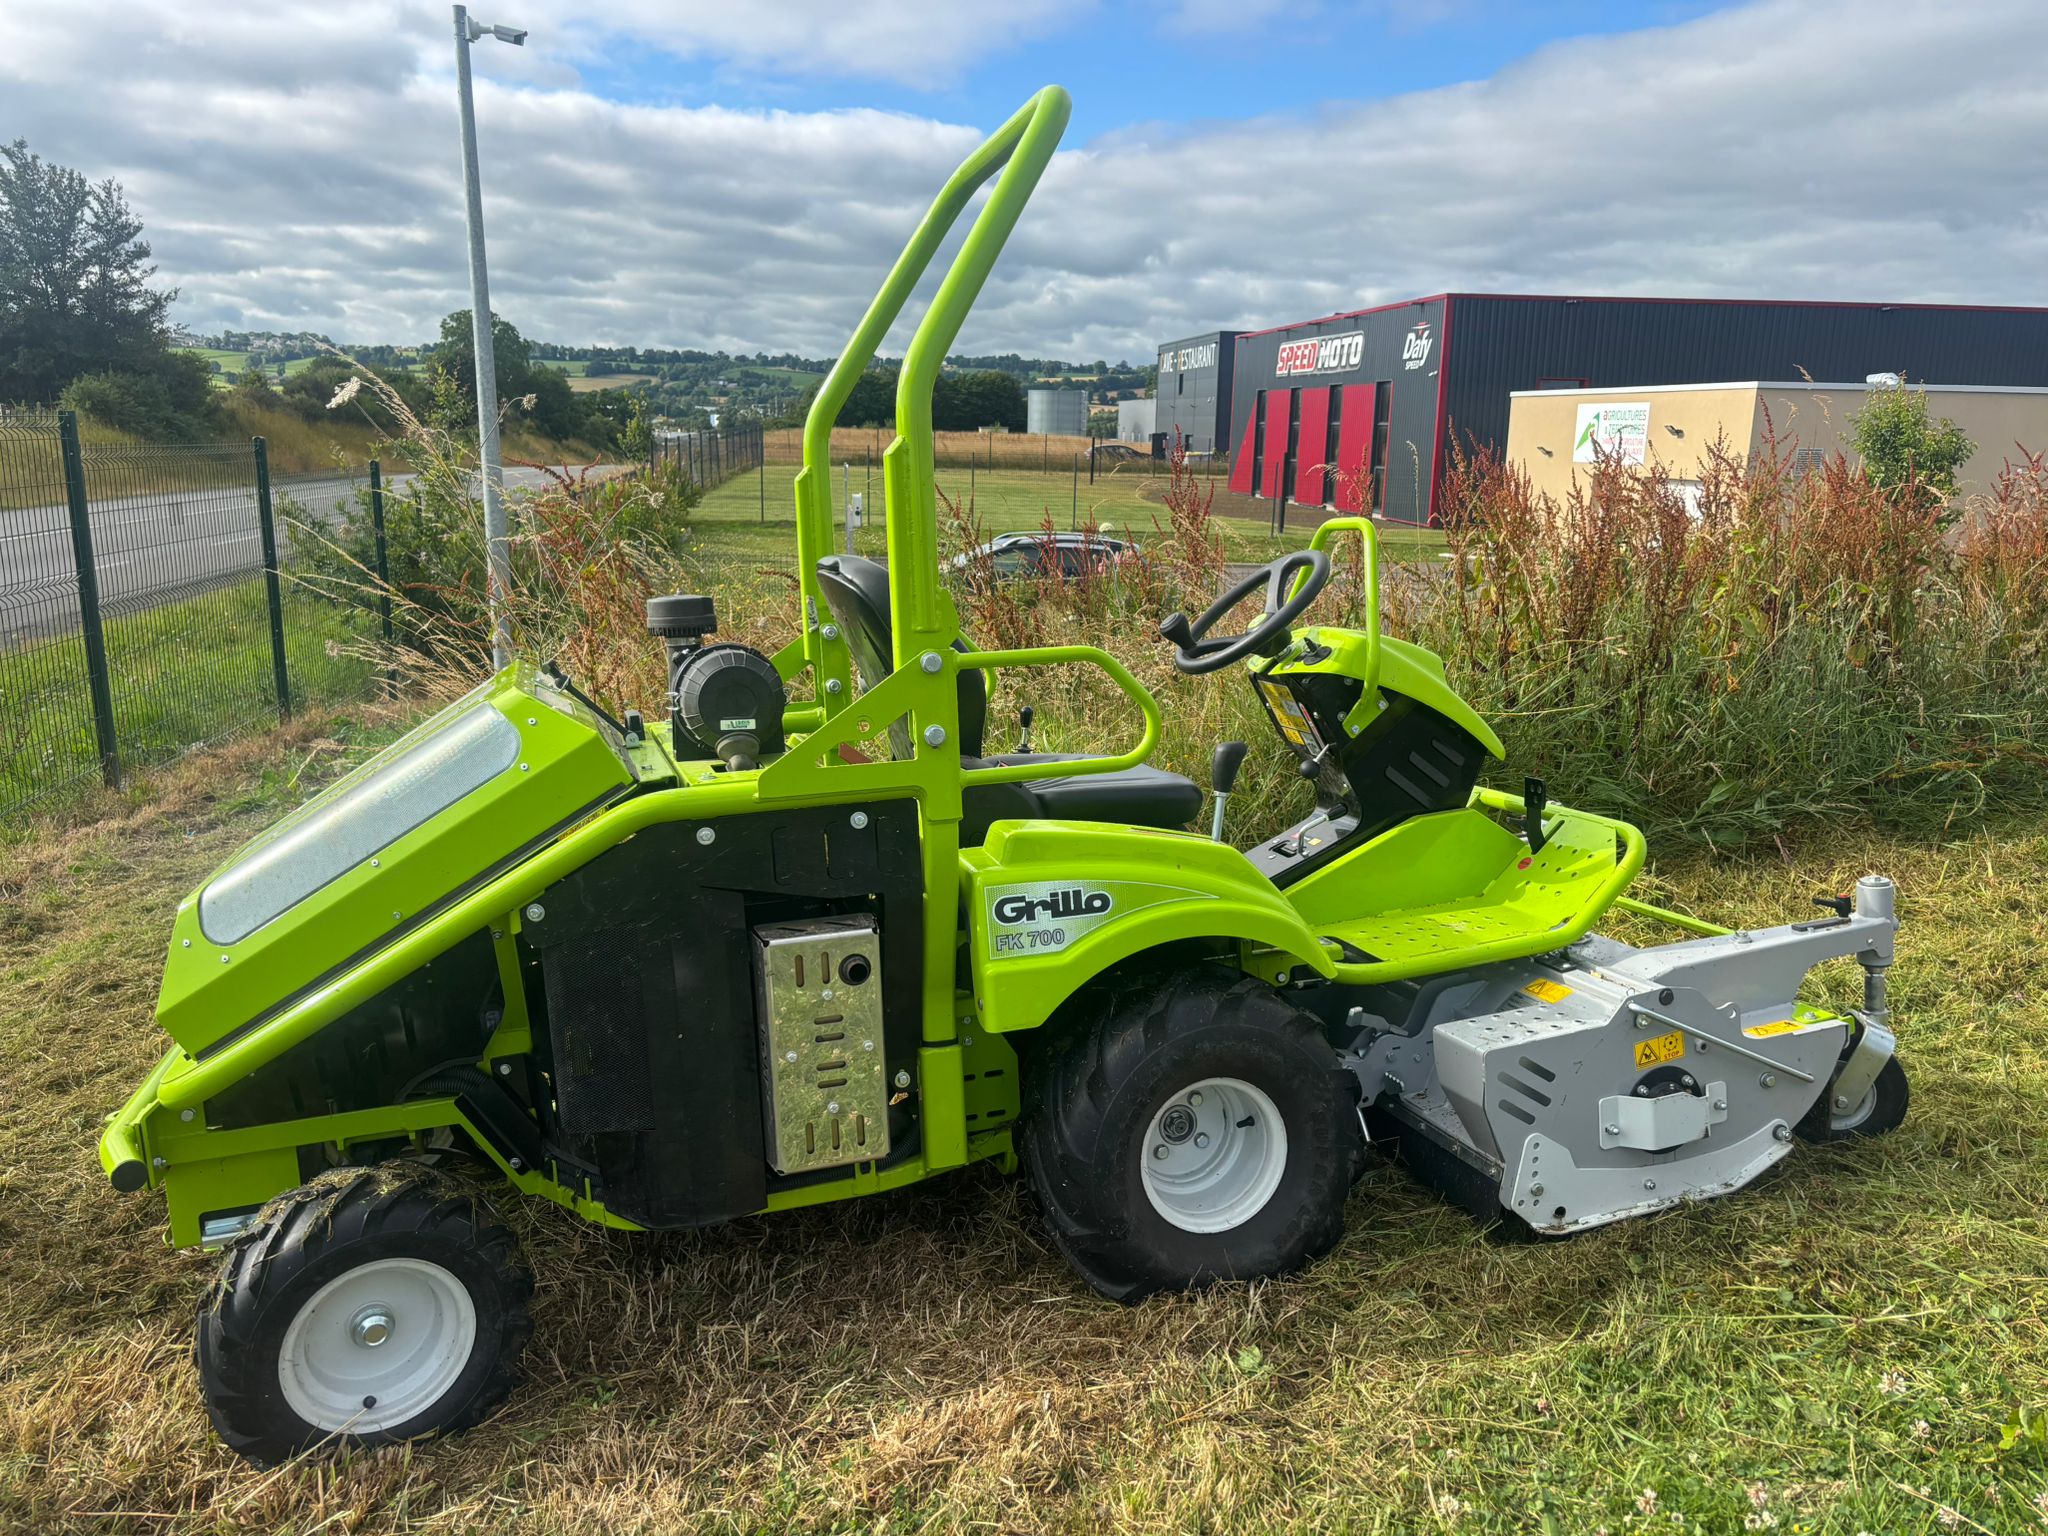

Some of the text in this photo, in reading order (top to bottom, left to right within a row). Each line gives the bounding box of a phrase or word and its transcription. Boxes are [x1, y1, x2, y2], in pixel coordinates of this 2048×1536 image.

[1178, 343, 1216, 371] RESTAURANT
[1276, 335, 1364, 373] SPEED MOTO
[1402, 330, 1433, 367] Dafy
[993, 888, 1112, 925] Grillo
[996, 928, 1066, 951] FK 700
[1663, 1051, 1680, 1060] STOP
